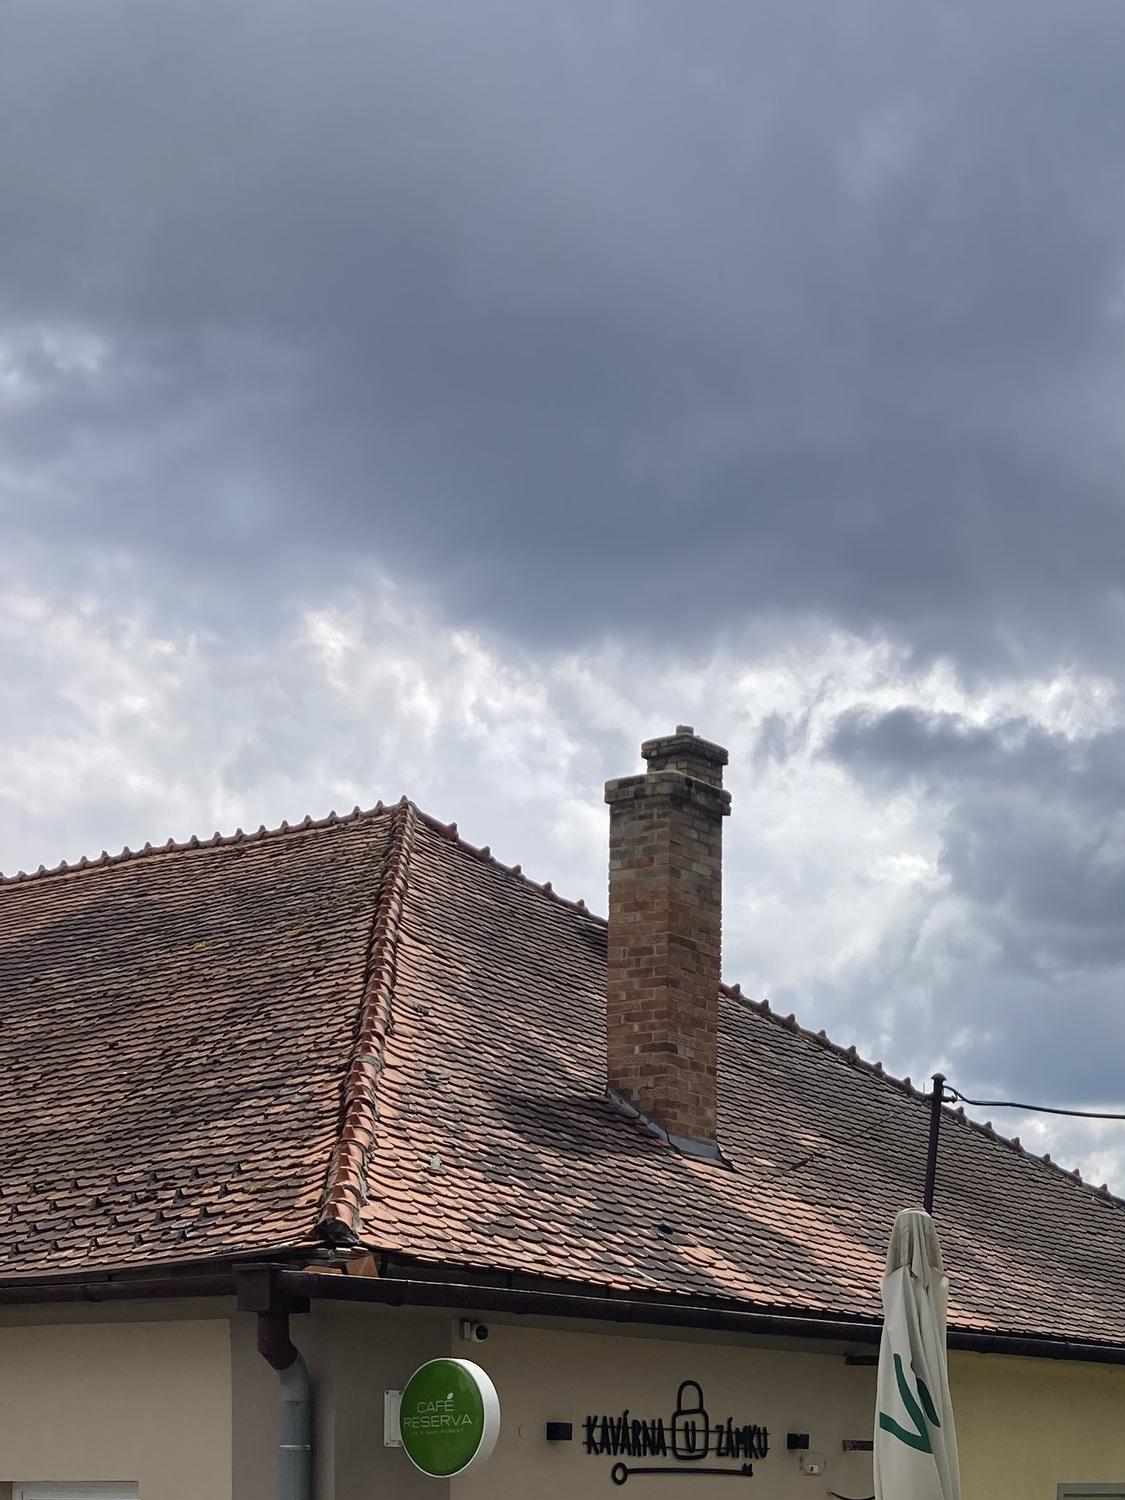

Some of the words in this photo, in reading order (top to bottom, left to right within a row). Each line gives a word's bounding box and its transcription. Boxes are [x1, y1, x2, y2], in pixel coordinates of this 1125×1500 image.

[416, 1392, 454, 1413] CAFÉ
[403, 1414, 472, 1428] RESERVA
[586, 1409, 667, 1457] KAVÁRNA
[684, 1420, 696, 1454] U
[715, 1416, 768, 1459] ZÁMKU
